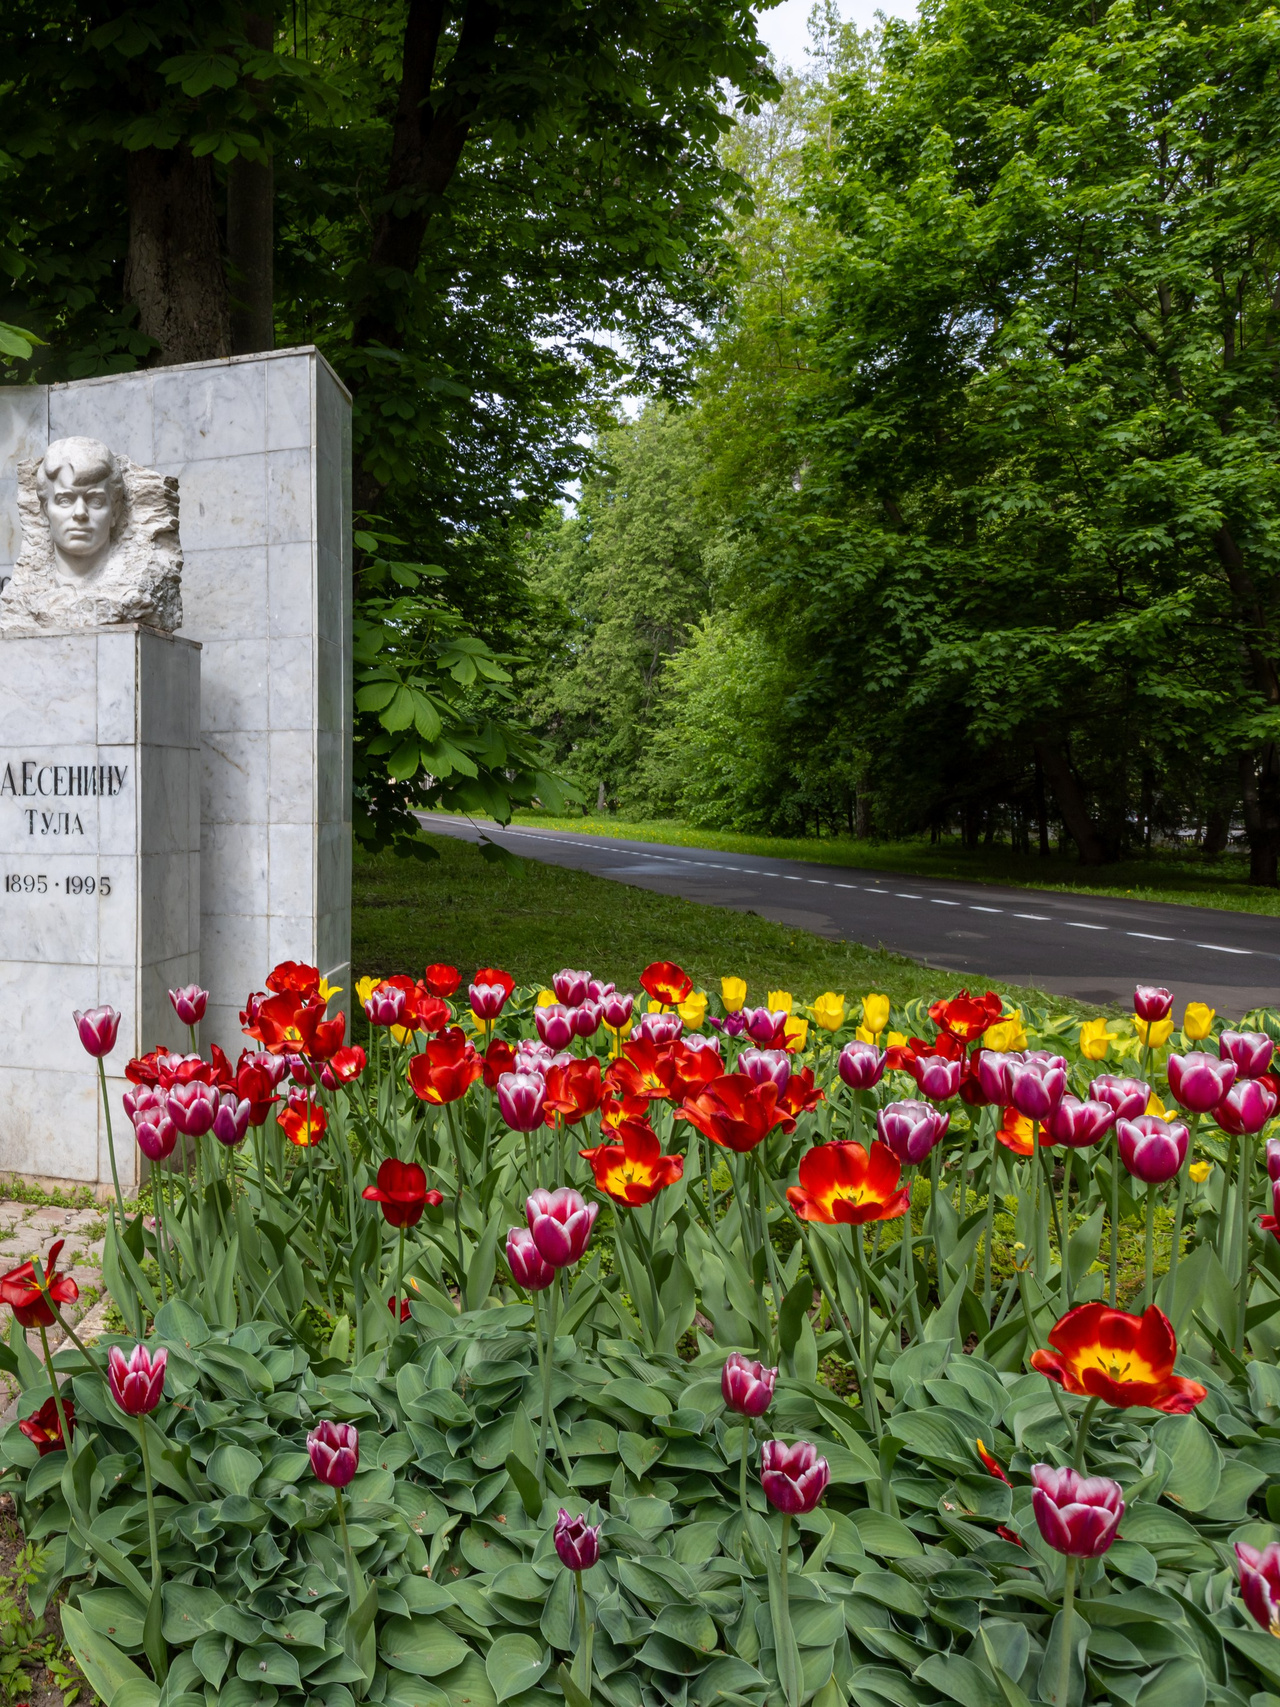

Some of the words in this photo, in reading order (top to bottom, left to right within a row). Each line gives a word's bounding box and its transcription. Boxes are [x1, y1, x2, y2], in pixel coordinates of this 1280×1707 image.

[24, 809, 85, 836] ТУЛА
[5, 874, 48, 894] 1895
[65, 875, 112, 896] 1995
